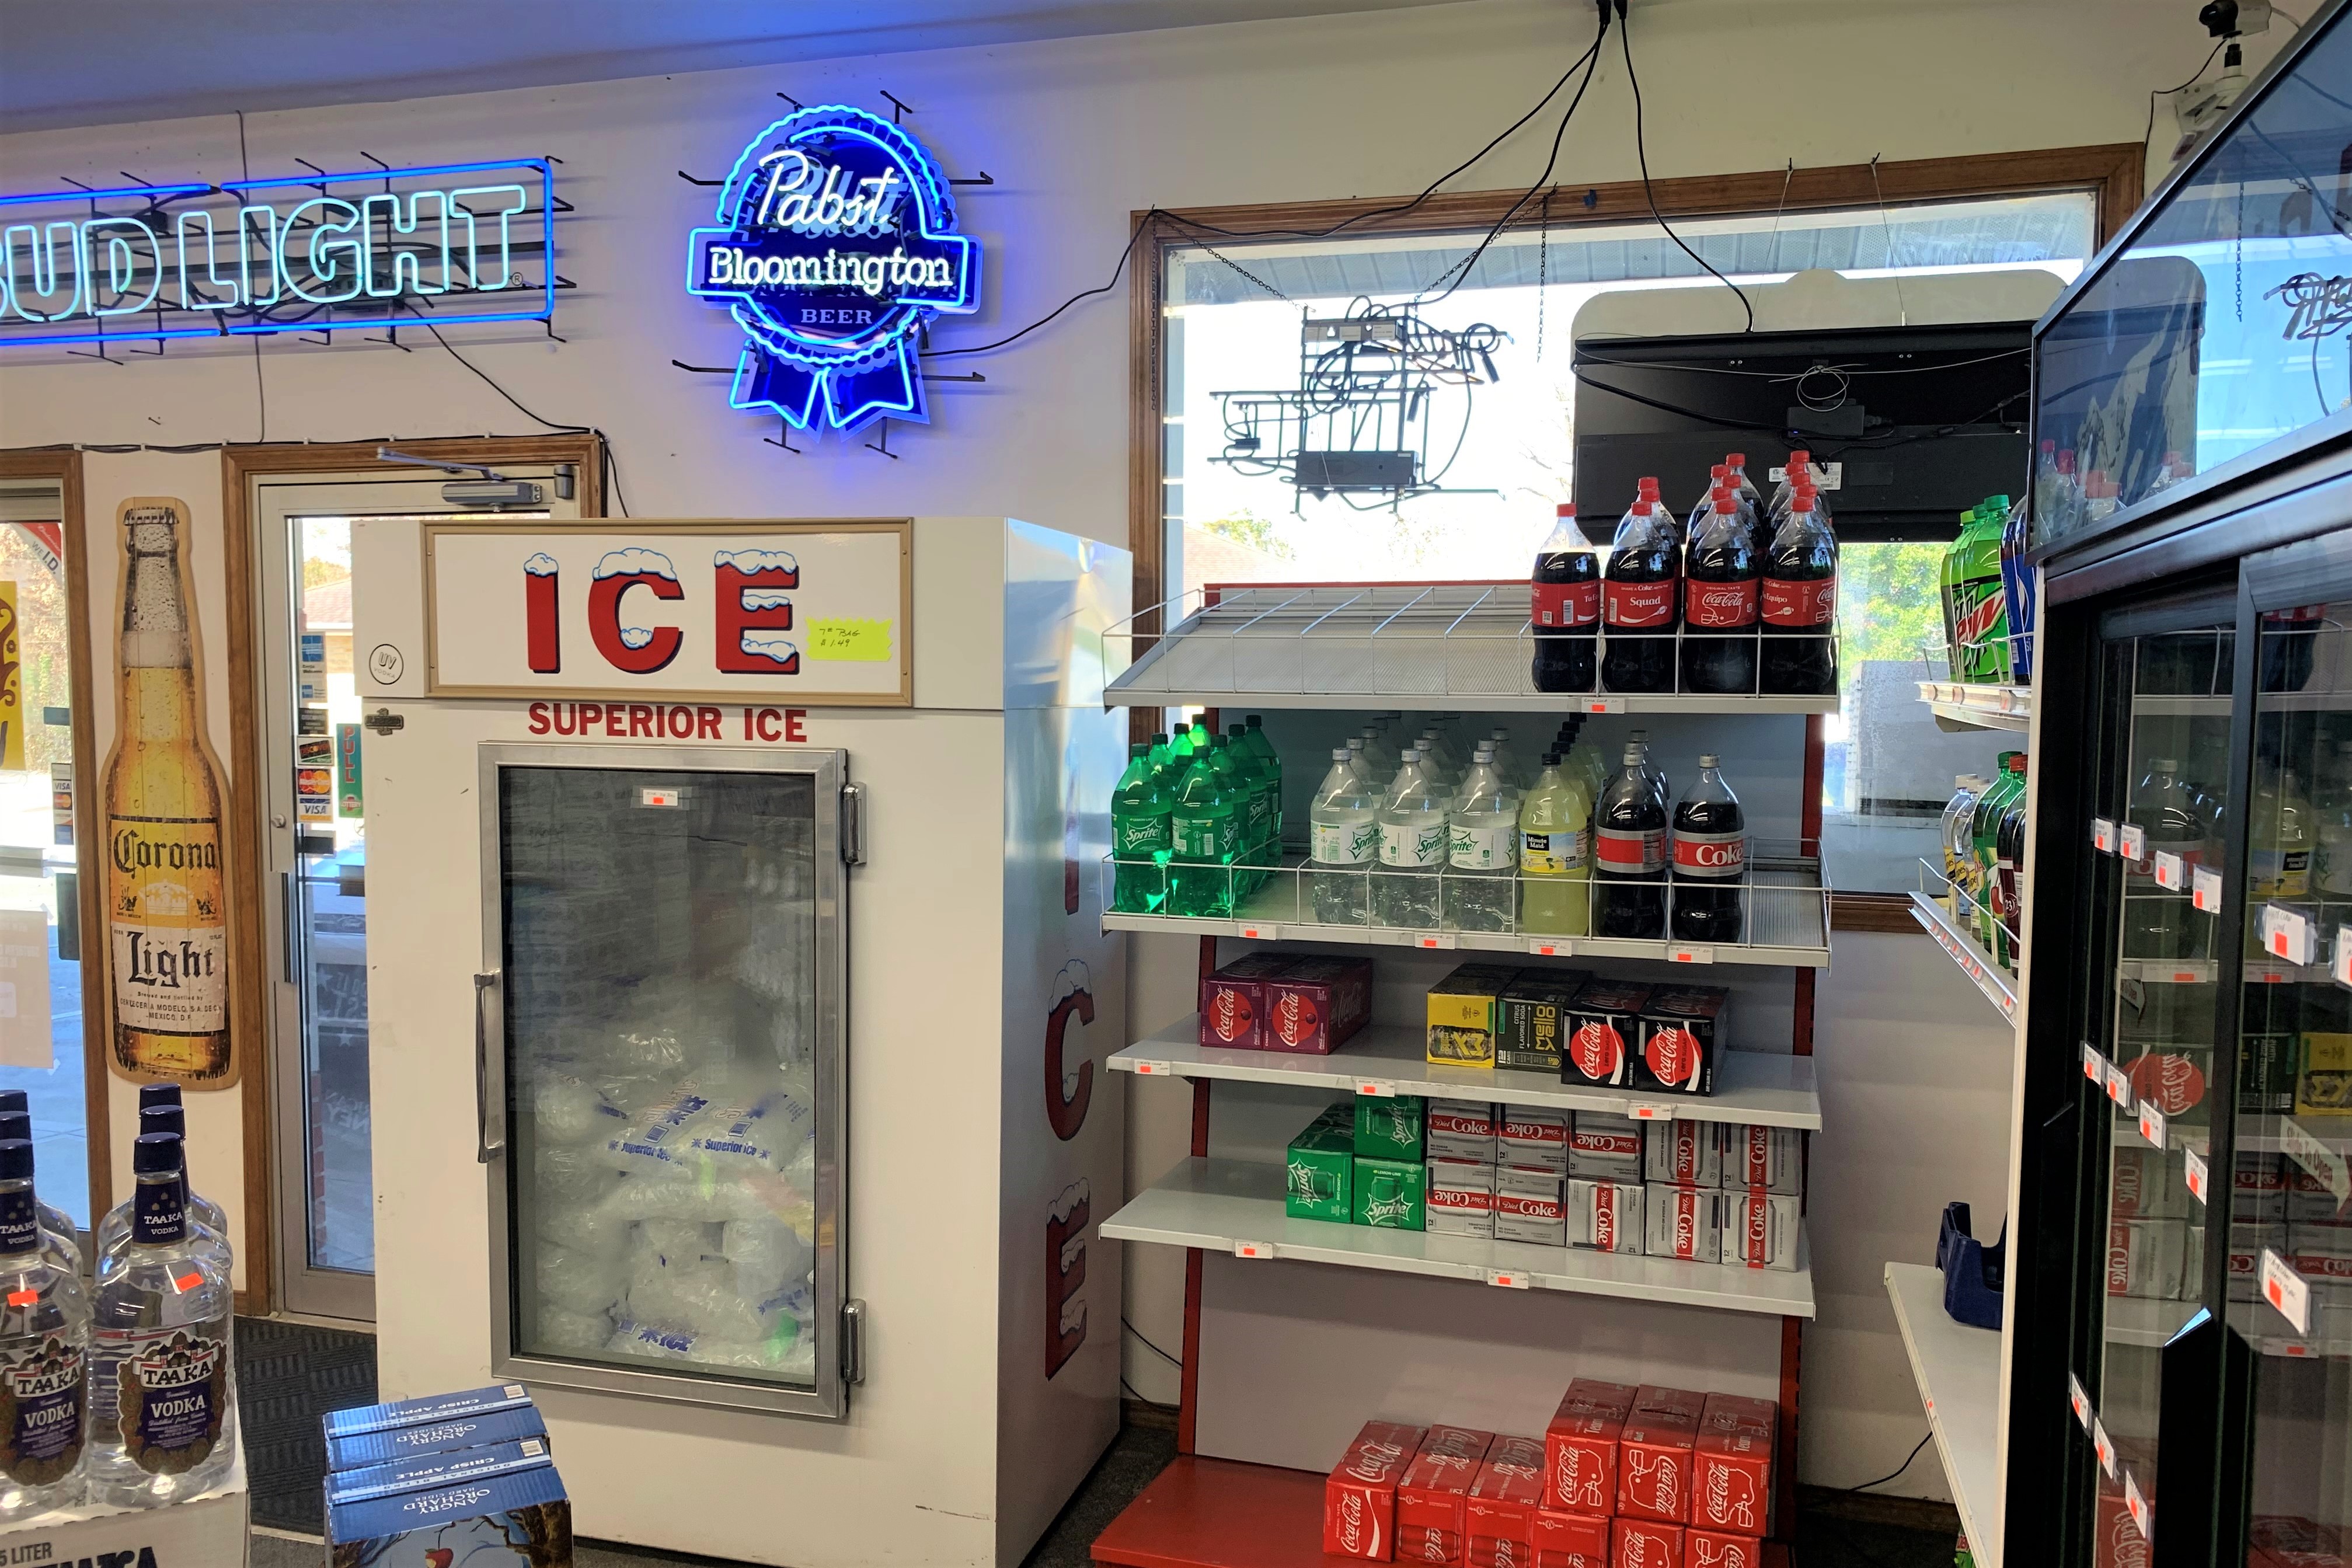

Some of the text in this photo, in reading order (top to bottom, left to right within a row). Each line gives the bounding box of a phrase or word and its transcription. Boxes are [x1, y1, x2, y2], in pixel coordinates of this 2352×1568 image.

[757, 149, 900, 227] Pabst
[0, 185, 526, 322] UD LIGHT
[708, 246, 954, 297] Bloomington
[800, 308, 873, 325] BEER
[1629, 596, 1661, 608] Squad
[1701, 591, 1745, 607] Coca-Cola
[1766, 593, 1787, 603] Equipo
[524, 547, 800, 675] ICE
[379, 651, 397, 670] UV
[374, 667, 396, 679] VODKA
[527, 702, 808, 743] SUPERIOR ICE
[344, 725, 355, 783] PULL
[304, 805, 327, 814] VISA
[1126, 828, 1159, 841] Sprite
[1528, 836, 1547, 844] Minute
[114, 829, 217, 880] Corona
[1696, 845, 1743, 865] Coke
[2005, 900, 2013, 911] 23
[126, 931, 214, 989] Light
[1216, 984, 1235, 1042] Coca-Cola
[1279, 988, 1299, 1047] Coca-Cola
[1498, 1050, 1506, 1064] 12
[1579, 1016, 1601, 1080] Coca-Cola
[1655, 1022, 1678, 1086] Coca-Cola
[1391, 1107, 1406, 1143] Sprite
[1434, 1117, 1487, 1134] Diet Coke
[1507, 1123, 1560, 1140] Diet Coke
[705, 1138, 743, 1154] Superior
[1577, 1135, 1633, 1151] Diet Coke
[1751, 1128, 1765, 1164] Coke
[1678, 1136, 1693, 1172] Coke
[1297, 1163, 1312, 1204] Sprite
[1725, 1174, 1731, 1182] 12
[1435, 1191, 1469, 1207] Coke
[1502, 1200, 1556, 1217] Diet Coke
[144, 1211, 183, 1224] TAAKA
[1368, 1202, 1407, 1217] Sprite
[1597, 1190, 1613, 1243] Diet Coke
[151, 1226, 179, 1235] VODKA
[1678, 1197, 1692, 1249] Diet Coke
[1750, 1204, 1765, 1241] Coke
[8, 1235, 34, 1245] VODKA
[1724, 1249, 1730, 1257] 12
[18, 1367, 79, 1395] TAAKA
[144, 1360, 212, 1385] TAAKA
[25, 1402, 75, 1428] VODKA
[151, 1395, 206, 1419] VODKA
[387, 1399, 480, 1417] CRISP APPLE
[396, 1423, 477, 1443] ORCHARD
[437, 1423, 462, 1431] HARD
[1583, 1419, 1604, 1434] Team
[410, 1431, 465, 1446] ANGRY
[1733, 1436, 1751, 1452] Team
[395, 1457, 495, 1480] CRISP APPLE
[1346, 1438, 1403, 1483] Coca-Cola
[1557, 1441, 1579, 1505] Coca-Cola
[414, 1486, 475, 1503] HARD CIDER
[1655, 1455, 1677, 1518] Coca-Cola
[1706, 1459, 1730, 1524] Coca-Cola
[403, 1488, 490, 1511] ORCHARD
[418, 1496, 478, 1514] ANGRY
[1340, 1490, 1362, 1553] Coca-Cola
[11, 1542, 53, 1564] LITER
